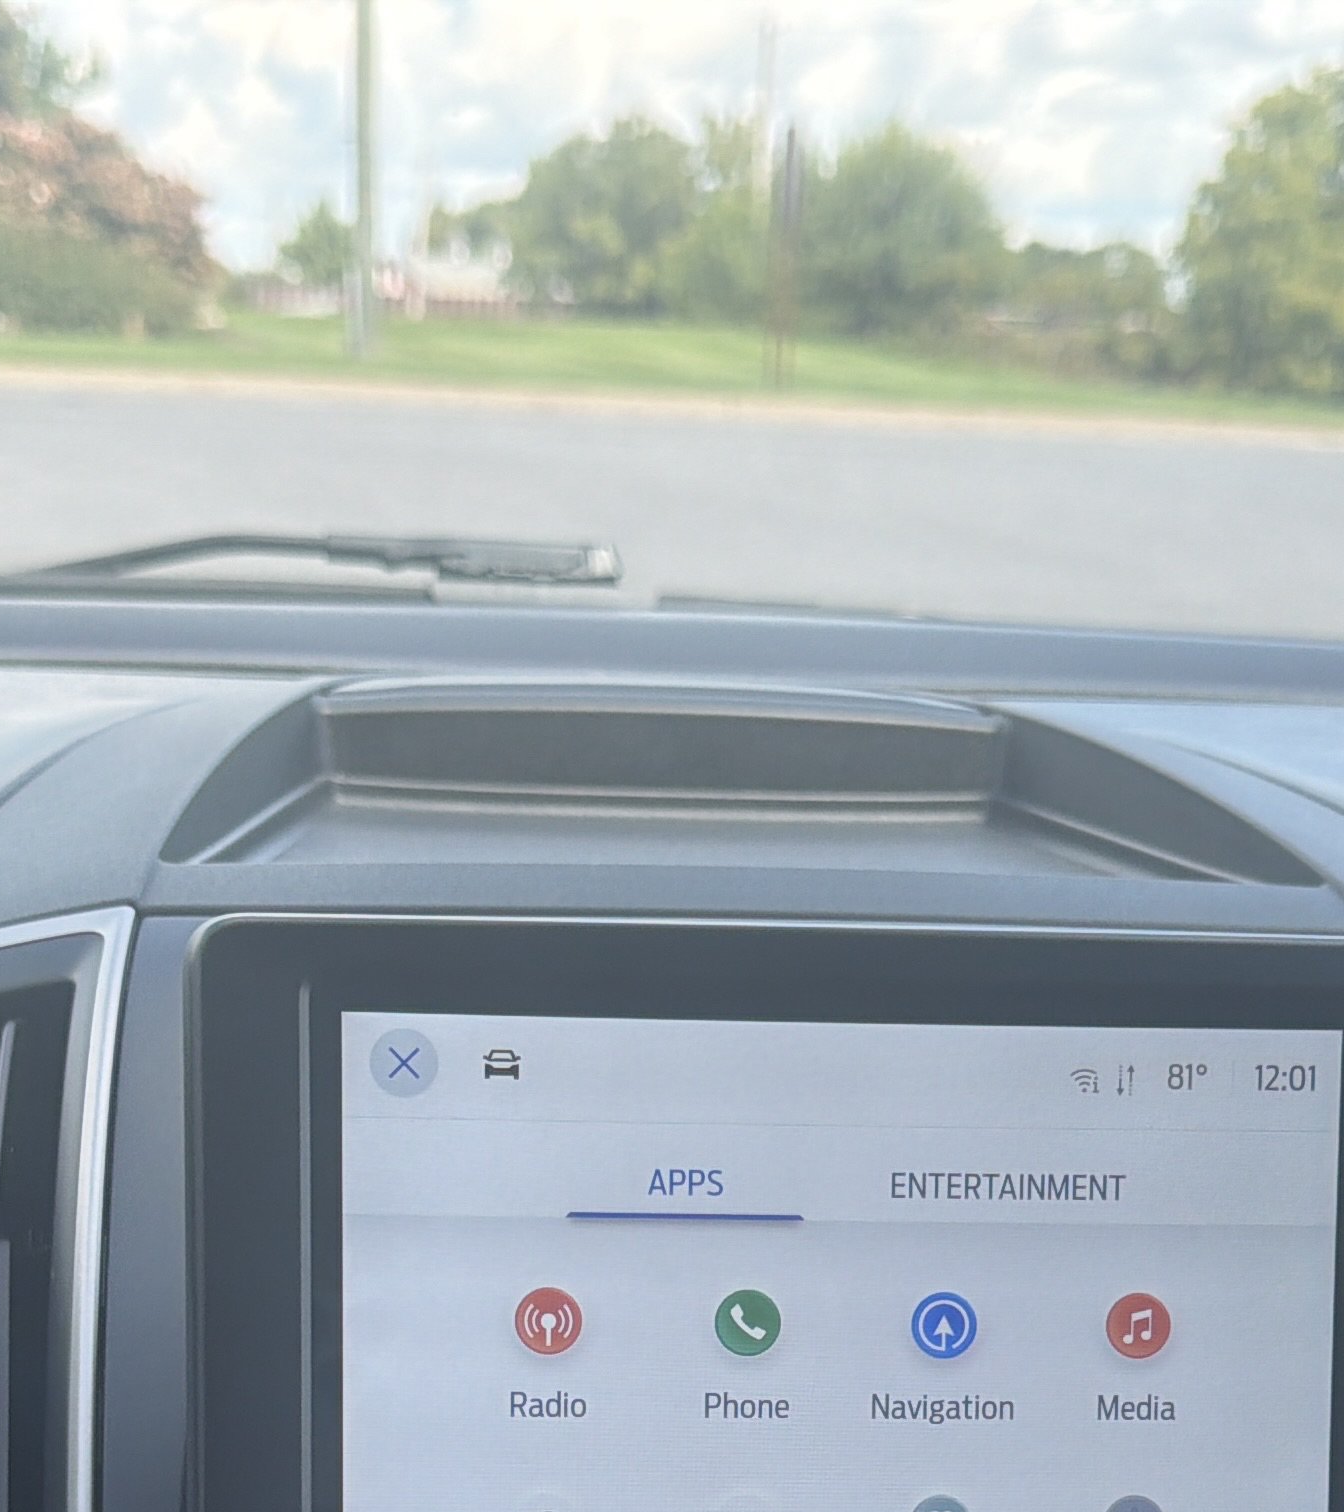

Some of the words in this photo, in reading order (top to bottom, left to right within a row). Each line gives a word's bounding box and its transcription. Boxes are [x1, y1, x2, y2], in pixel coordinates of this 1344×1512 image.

[1167, 1063, 1208, 1091] 81°
[1254, 1064, 1316, 1092] 12:01
[647, 1168, 724, 1197] APPS
[890, 1171, 1127, 1202] ENTERTAINMENT
[510, 1390, 587, 1418] Radio
[704, 1391, 790, 1419] Phone
[871, 1393, 1014, 1425] Navigation
[1097, 1393, 1176, 1421] Media
